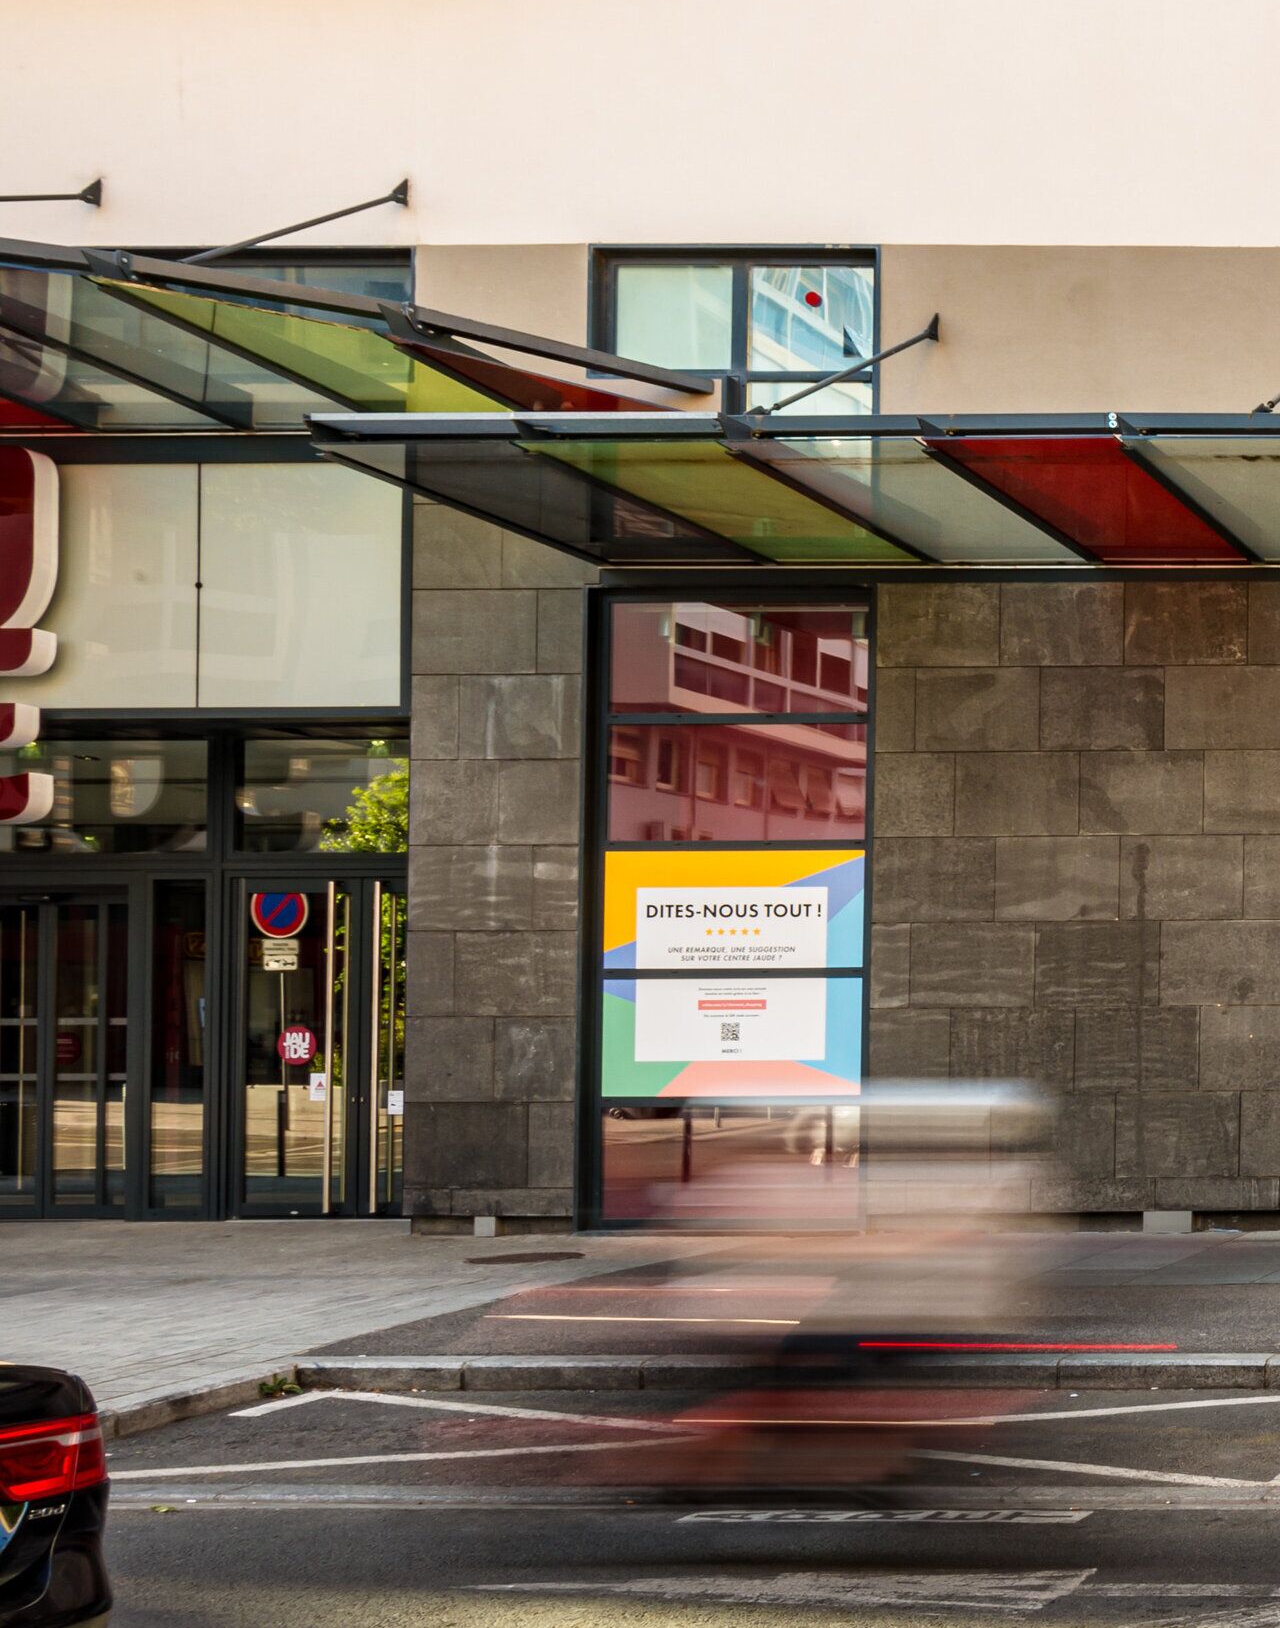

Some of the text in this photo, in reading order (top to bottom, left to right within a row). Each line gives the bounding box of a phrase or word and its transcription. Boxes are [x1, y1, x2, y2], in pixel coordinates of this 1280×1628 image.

[646, 904, 759, 918] DITES-NOUS
[764, 903, 812, 918] TOUT
[668, 946, 683, 954] UNE
[730, 946, 746, 954] UNE
[680, 954, 695, 962] SUR
[698, 954, 721, 962] VOTRE
[28, 1503, 66, 1521] 20d
